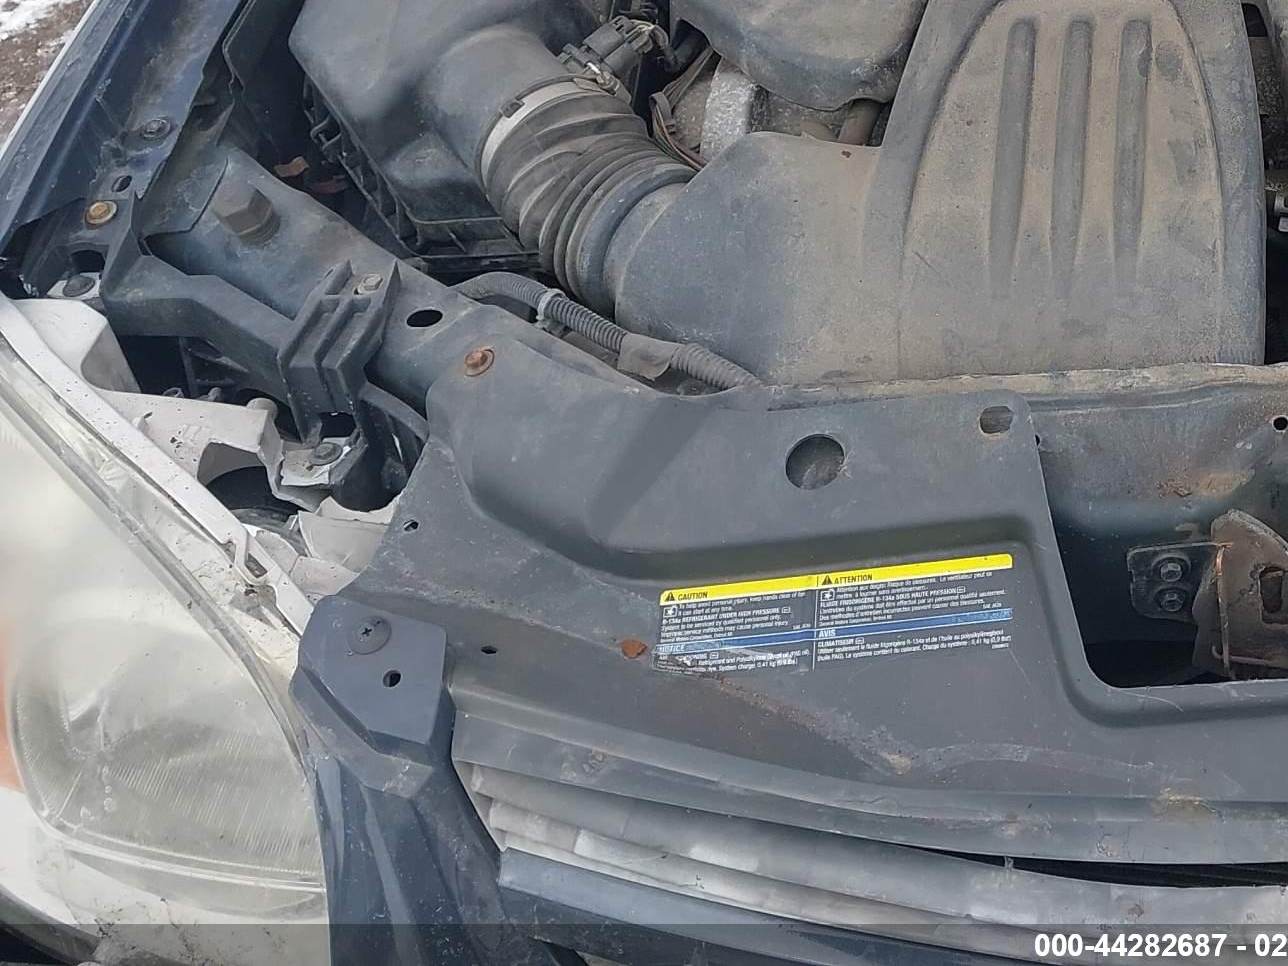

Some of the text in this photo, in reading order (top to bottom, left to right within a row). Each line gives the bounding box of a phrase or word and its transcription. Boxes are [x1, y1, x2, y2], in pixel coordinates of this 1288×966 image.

[834, 574, 872, 584] ATTENTION
[677, 591, 707, 600] CAUTION
[818, 629, 835, 637] AVIS
